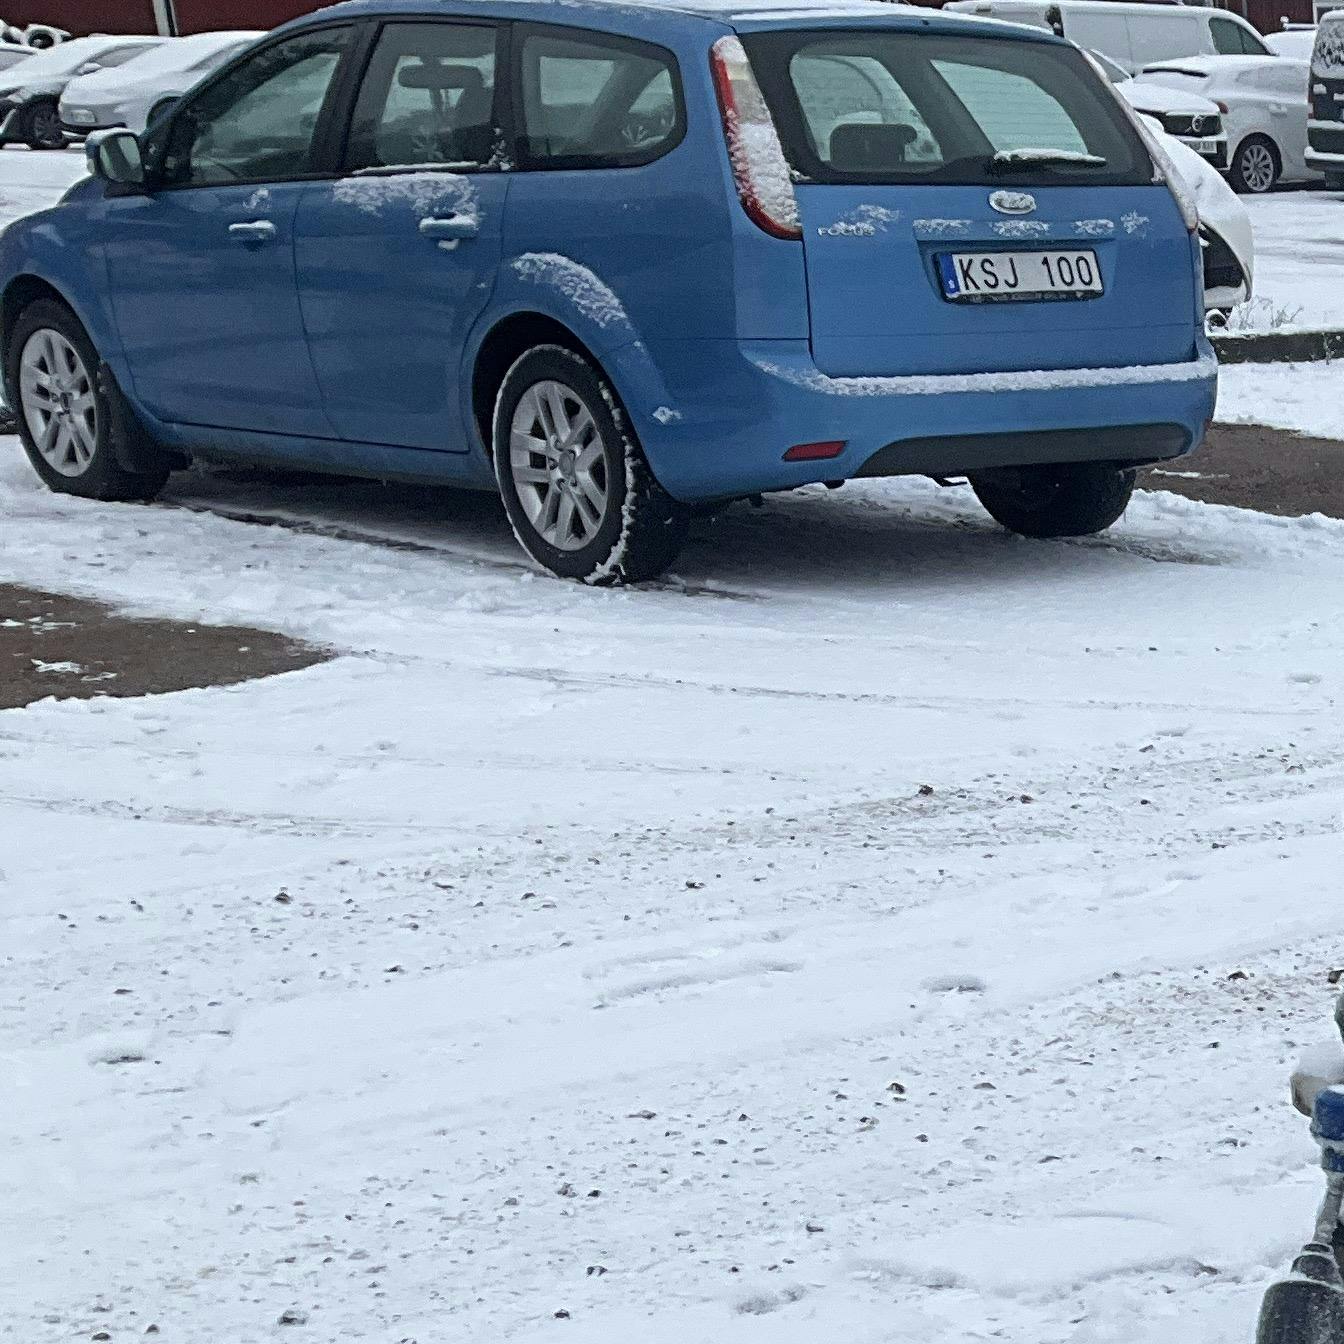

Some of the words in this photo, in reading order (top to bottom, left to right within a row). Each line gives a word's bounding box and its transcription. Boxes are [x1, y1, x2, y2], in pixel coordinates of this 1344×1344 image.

[817, 226, 876, 237] FOCUS
[959, 257, 1019, 290] KSJ
[1041, 256, 1093, 287] 100
